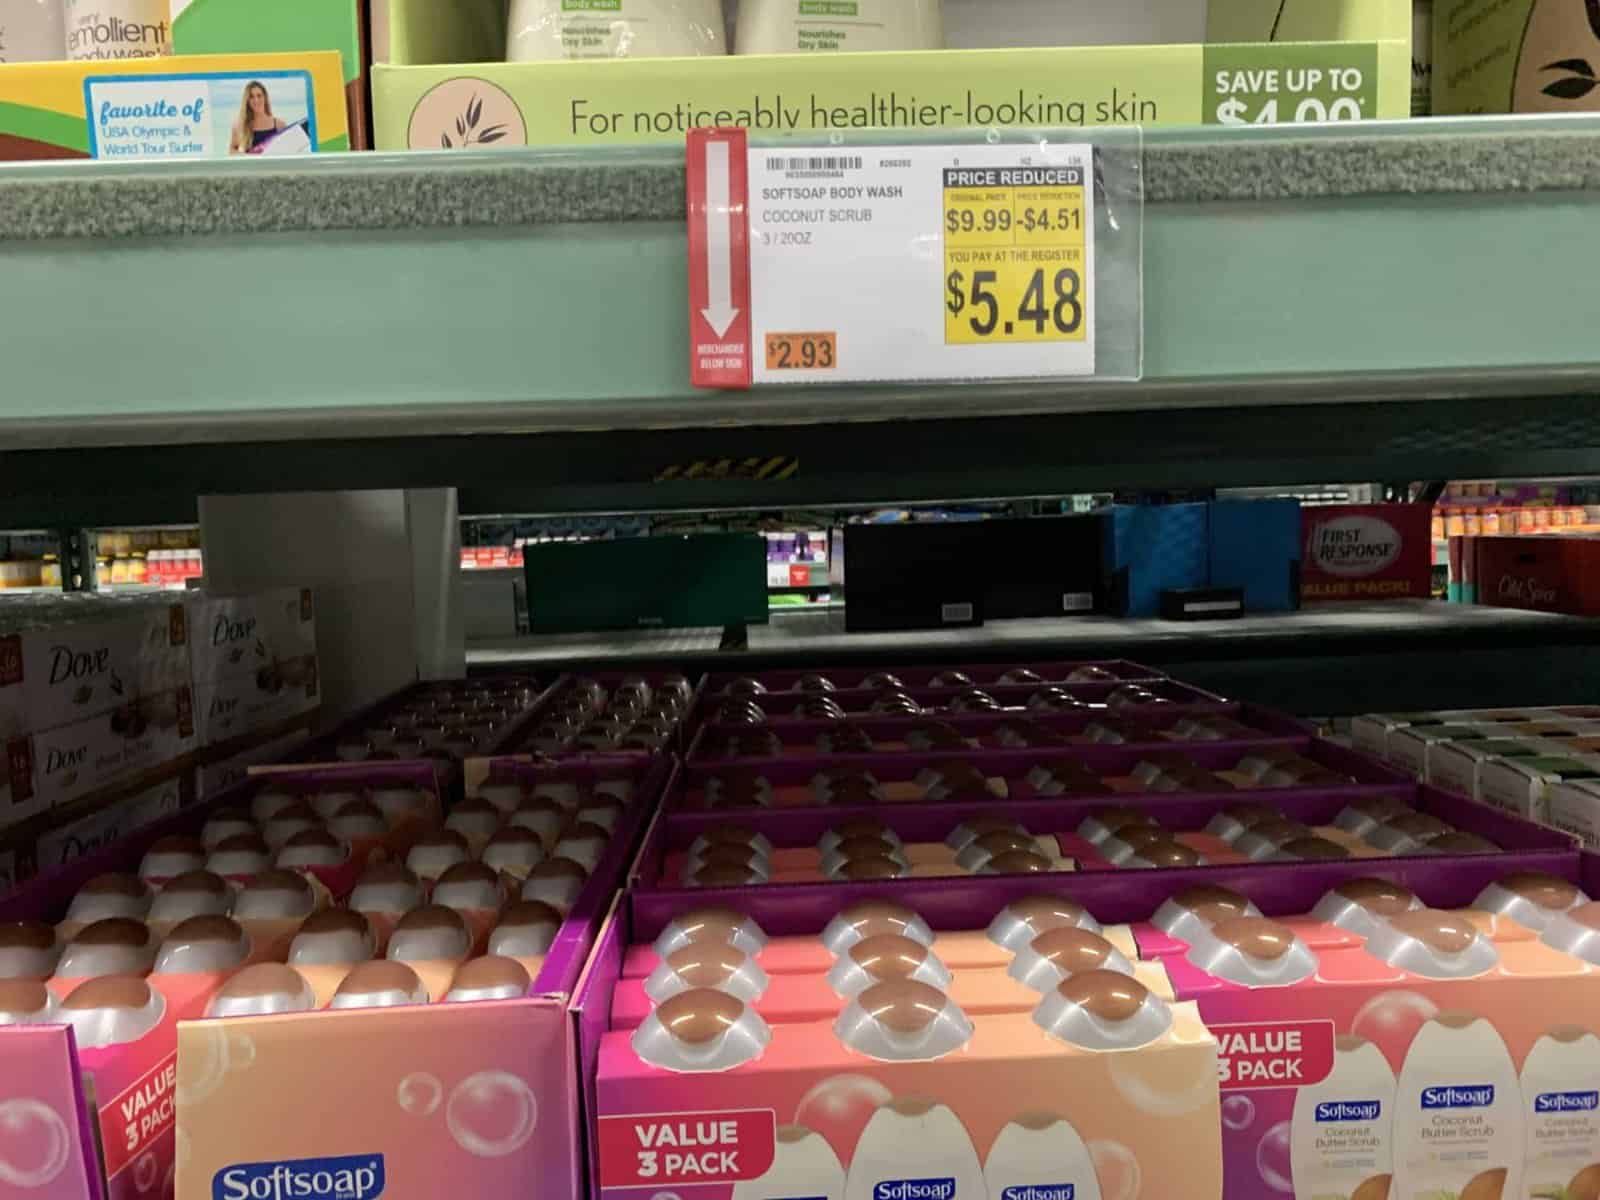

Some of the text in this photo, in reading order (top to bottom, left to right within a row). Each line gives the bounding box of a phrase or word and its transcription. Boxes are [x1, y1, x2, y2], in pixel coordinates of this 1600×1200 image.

[69, 17, 167, 50] emollient
[1215, 67, 1362, 93] SAVE UP TO
[100, 97, 204, 125] favorite of
[571, 88, 1157, 134] For noticeably healthier-looking skin
[103, 127, 128, 137] USA
[946, 170, 1079, 186] PRICE REDUCED
[762, 186, 903, 200] SOFTSOAP BODY WASH
[762, 208, 872, 223] COCONUT SCRUB
[946, 208, 1012, 235] $9.99
[1016, 207, 1080, 232] -$4.51
[763, 232, 770, 245] 3
[949, 250, 1080, 264] YOU PAY AT THE REGISTER
[947, 267, 1082, 336] $5.48
[768, 339, 833, 369] $2.93
[1322, 528, 1361, 543] FIRST
[1320, 543, 1393, 559] RESPONSE
[1302, 582, 1348, 595] ALUE
[213, 614, 256, 647] Dove
[49, 645, 110, 685] Dove
[46, 746, 87, 774] Dove
[1216, 1031, 1302, 1055] VALUE
[1217, 1058, 1303, 1081] 3 PACK
[121, 1063, 176, 1122] VALUE
[1426, 1087, 1492, 1106] Softsoap
[1539, 1093, 1597, 1111] Softsoap
[1319, 1102, 1378, 1119] Softsoap
[125, 1121, 139, 1151] 3
[634, 1120, 738, 1147] VALUE
[637, 1151, 740, 1177] 3 PACK
[223, 1165, 376, 1200] Softsoap
[878, 1182, 952, 1200] Softsoap
